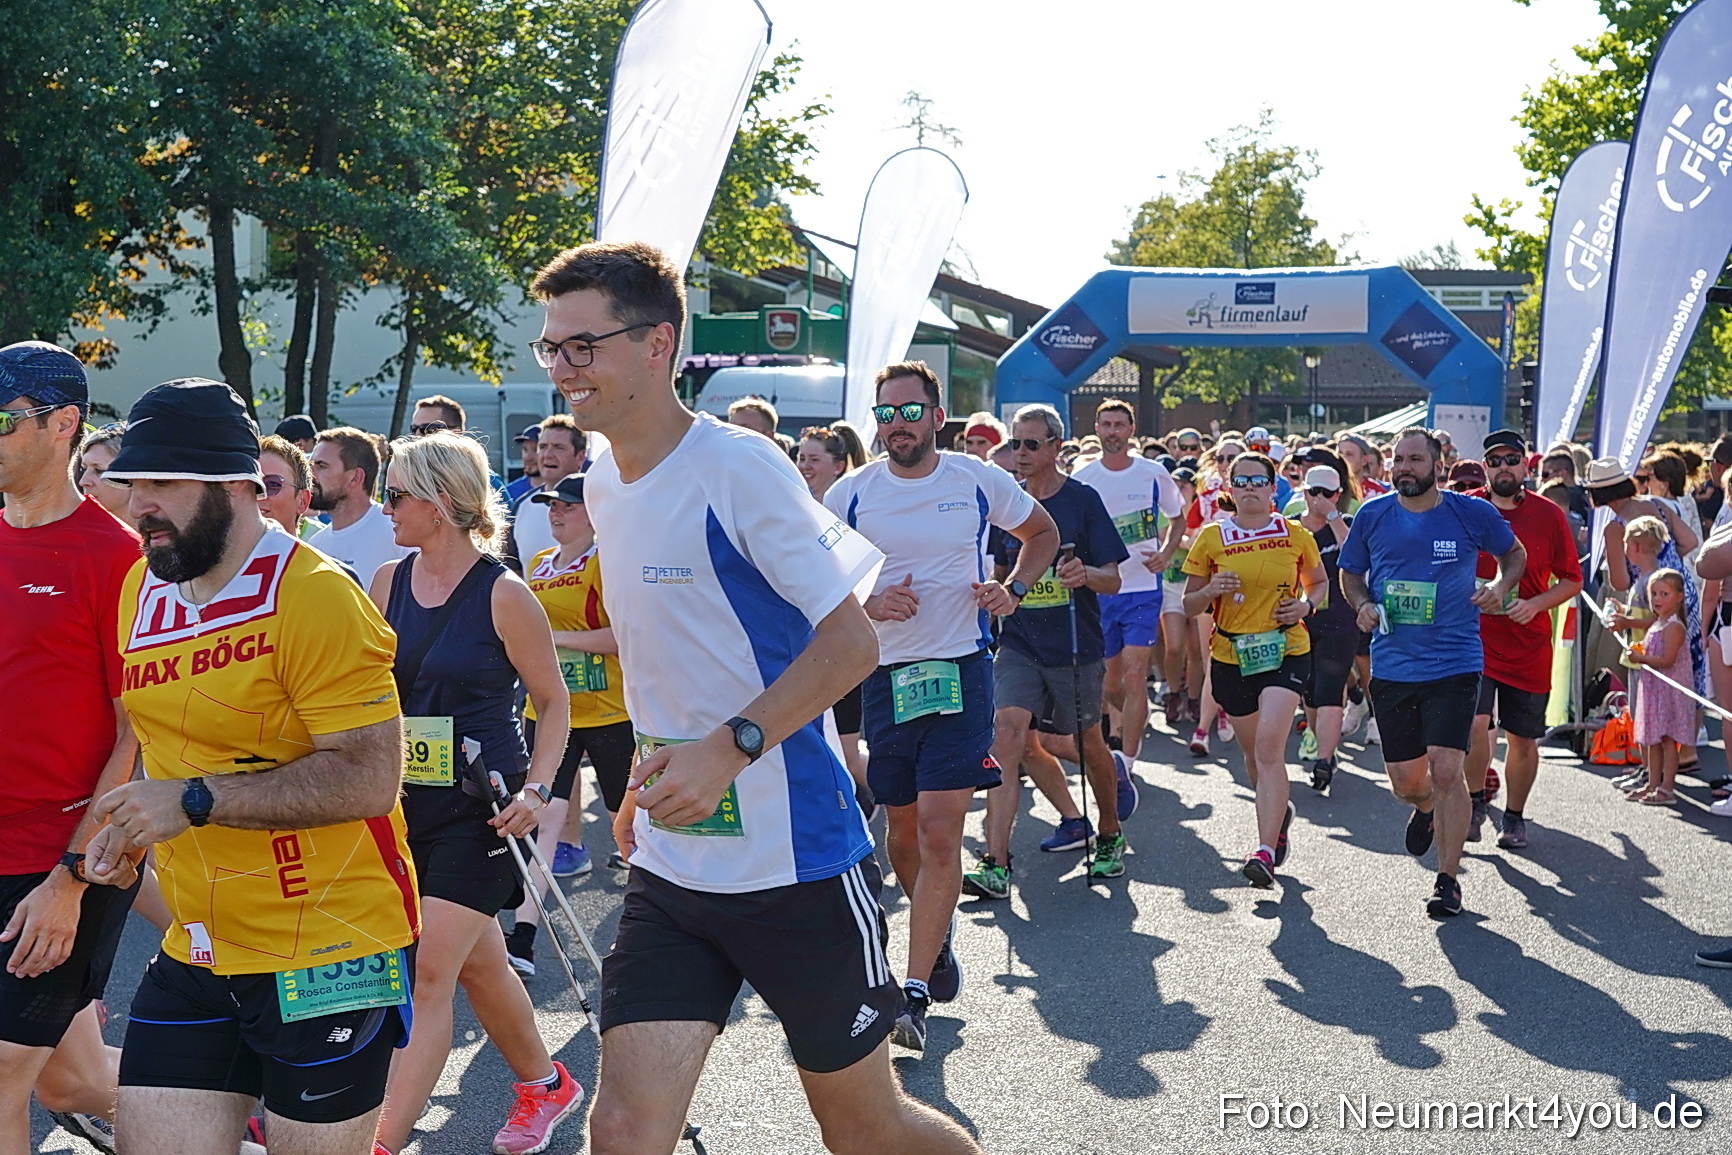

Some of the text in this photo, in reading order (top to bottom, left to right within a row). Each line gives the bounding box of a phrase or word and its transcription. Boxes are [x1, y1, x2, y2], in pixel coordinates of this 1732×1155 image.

[1580, 167, 1624, 271] Fischer
[1221, 304, 1309, 323] firmenlauf
[1049, 331, 1098, 345] Fischer
[1224, 539, 1293, 557] MAX BÖGL
[1433, 540, 1457, 549] DESS
[659, 567, 693, 578] PETTER
[659, 577, 694, 585] INGENIEURE
[28, 585, 55, 594] DEHN
[548, 575, 583, 590] BÖGL
[1393, 596, 1420, 610] 140
[122, 631, 275, 692] MAX BÖGL
[1243, 643, 1279, 662] 1589
[576, 663, 585, 686] 2022
[908, 677, 940, 701] 311
[950, 681, 960, 704] 2022
[407, 764, 435, 774] Kerstin
[439, 744, 449, 777] 2022
[297, 976, 391, 1000] Rosca Constantin
[850, 1009, 880, 1038] adidas
